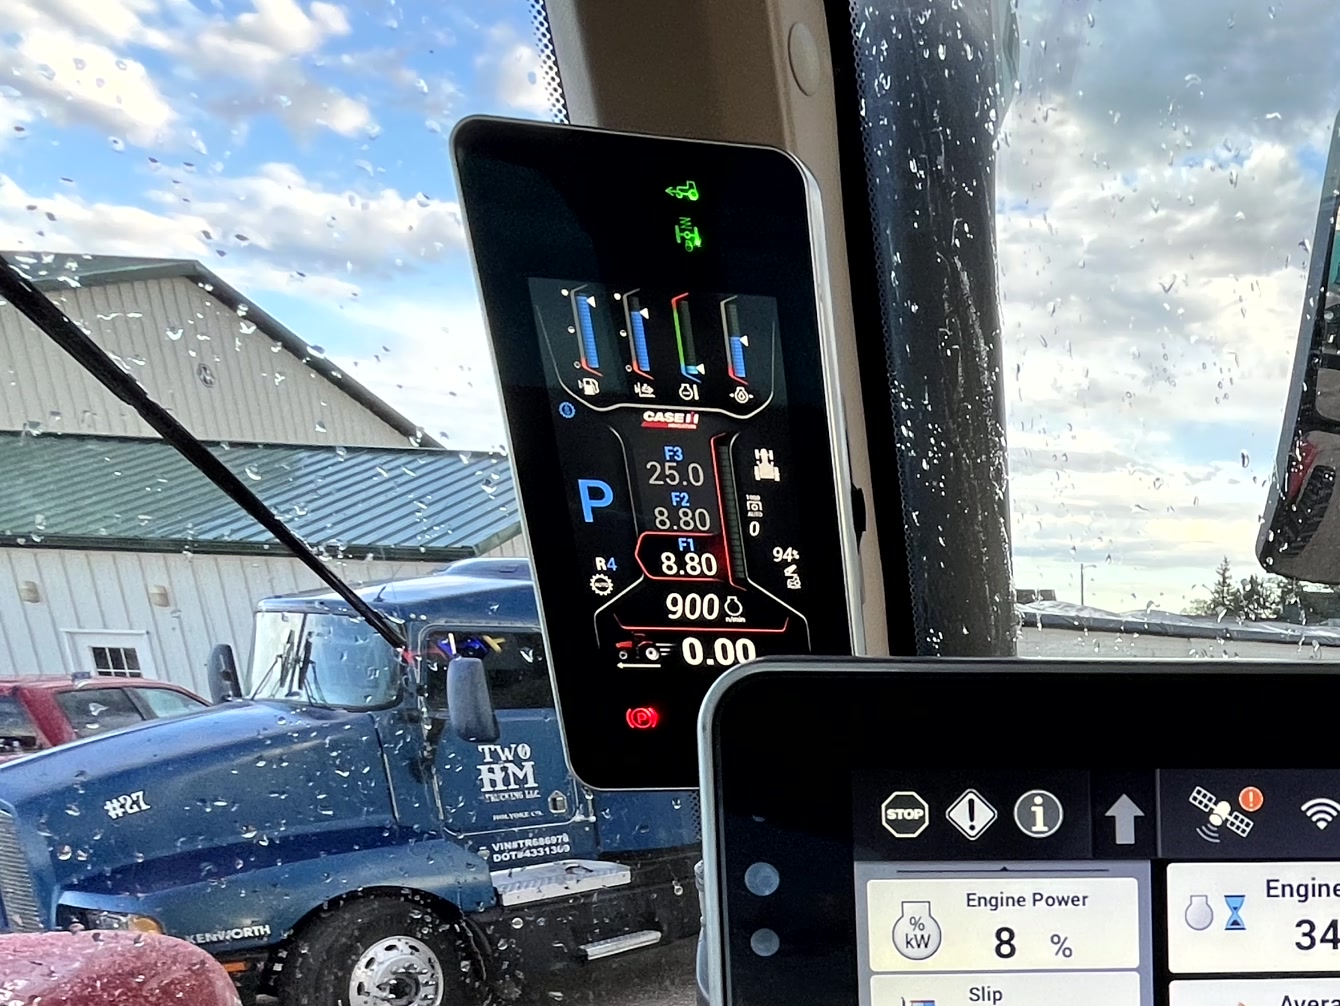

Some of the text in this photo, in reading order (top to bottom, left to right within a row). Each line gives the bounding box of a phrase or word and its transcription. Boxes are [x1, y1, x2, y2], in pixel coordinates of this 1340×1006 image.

[643, 410, 685, 423] CASE
[664, 446, 683, 461] F3
[646, 461, 704, 486] 25.0
[577, 479, 614, 522] P
[671, 492, 689, 507] F2
[654, 507, 711, 531] 8.80
[749, 521, 760, 537] 0
[678, 538, 695, 552] F1
[772, 546, 800, 563] 94%
[595, 557, 618, 571] R4
[660, 552, 718, 576] 8.80
[665, 592, 720, 620] 900
[682, 636, 756, 666] 0.00
[477, 743, 531, 762] TWO
[476, 761, 539, 792] HM
[103, 790, 151, 819] #27
[887, 808, 924, 820] STOP
[966, 892, 1089, 911] Engine Power
[185, 924, 271, 944] KENWORTH
[905, 934, 931, 949] kW
[995, 927, 1073, 959] 8 %
[969, 986, 1003, 1004] Slip
